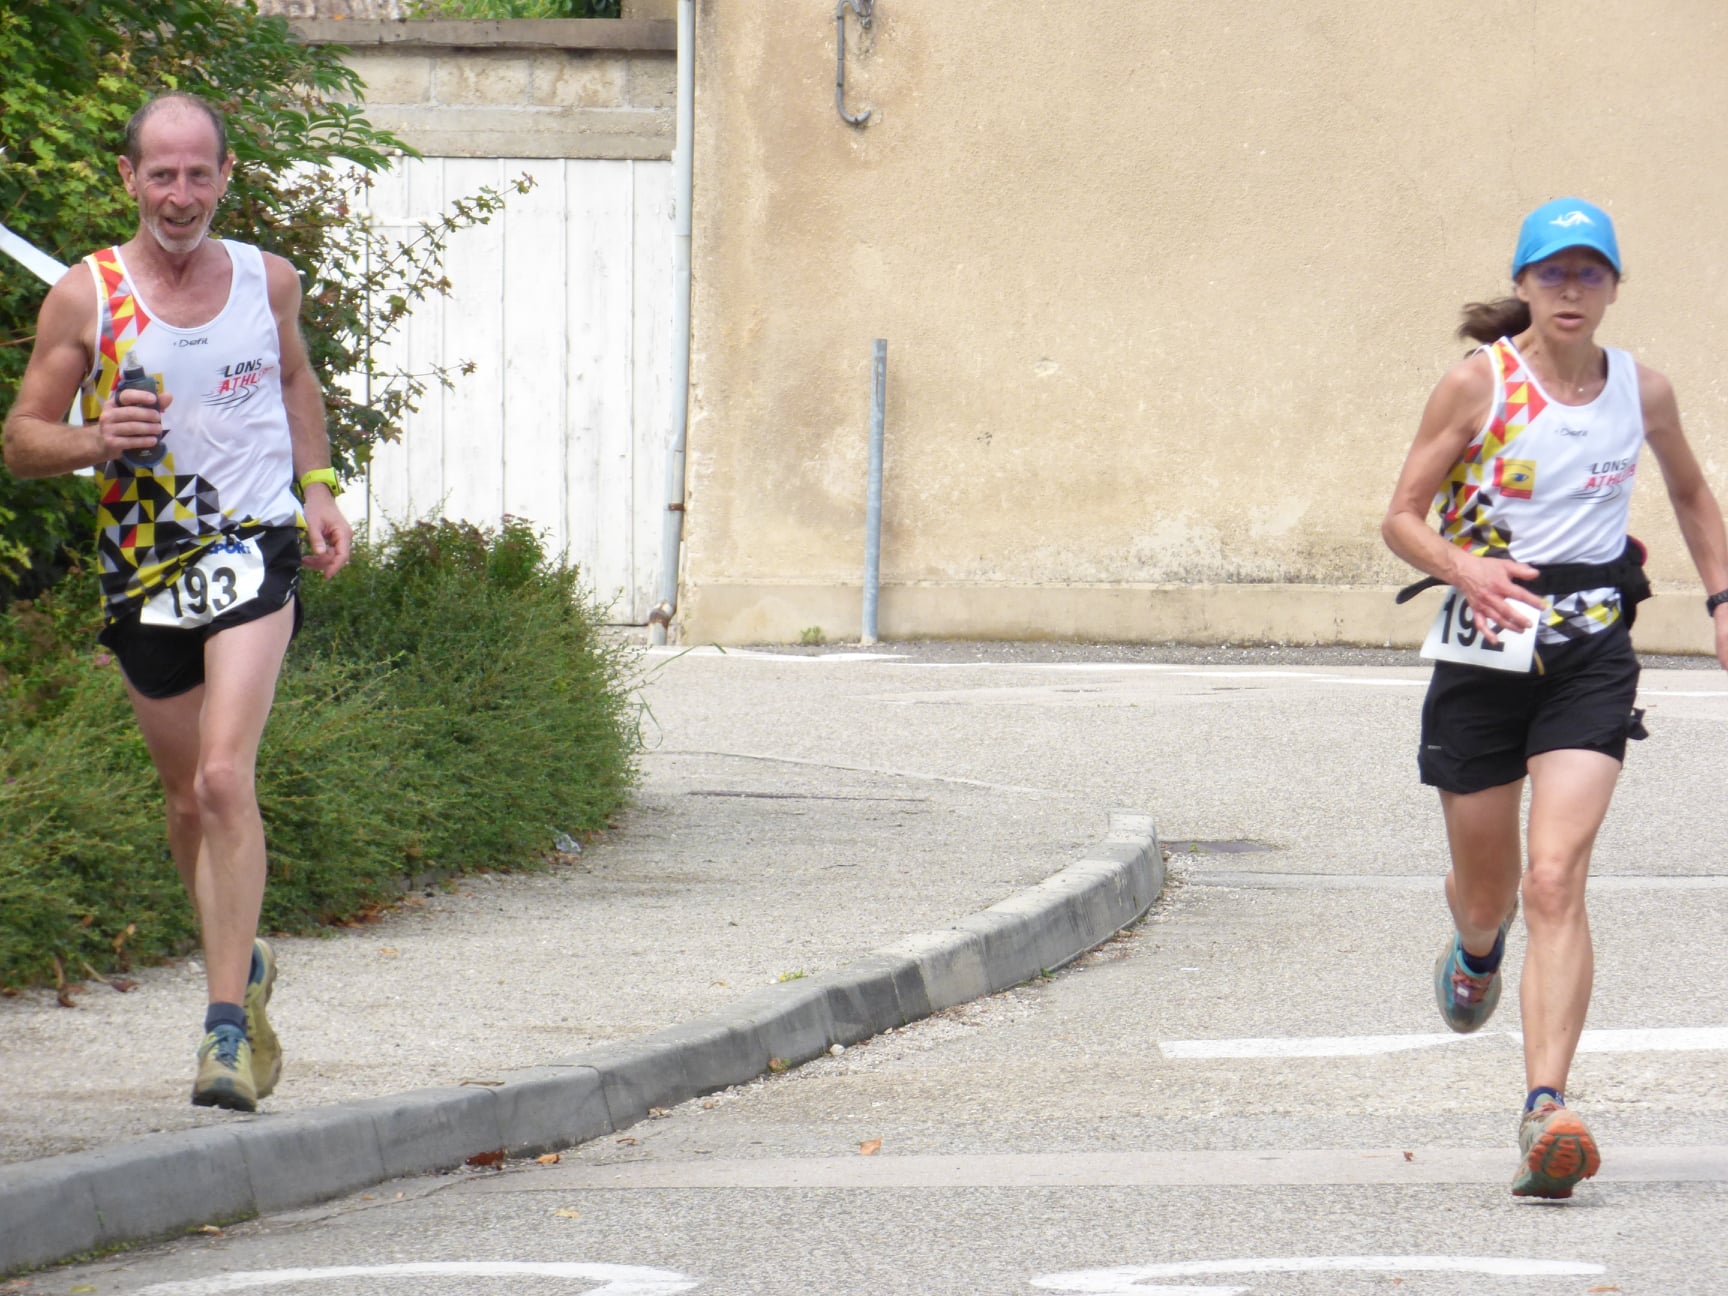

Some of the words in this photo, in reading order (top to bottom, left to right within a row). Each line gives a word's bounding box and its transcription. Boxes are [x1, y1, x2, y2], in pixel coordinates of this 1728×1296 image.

[223, 358, 263, 378] LONS
[1591, 458, 1629, 475] LONS
[170, 565, 238, 618] 193
